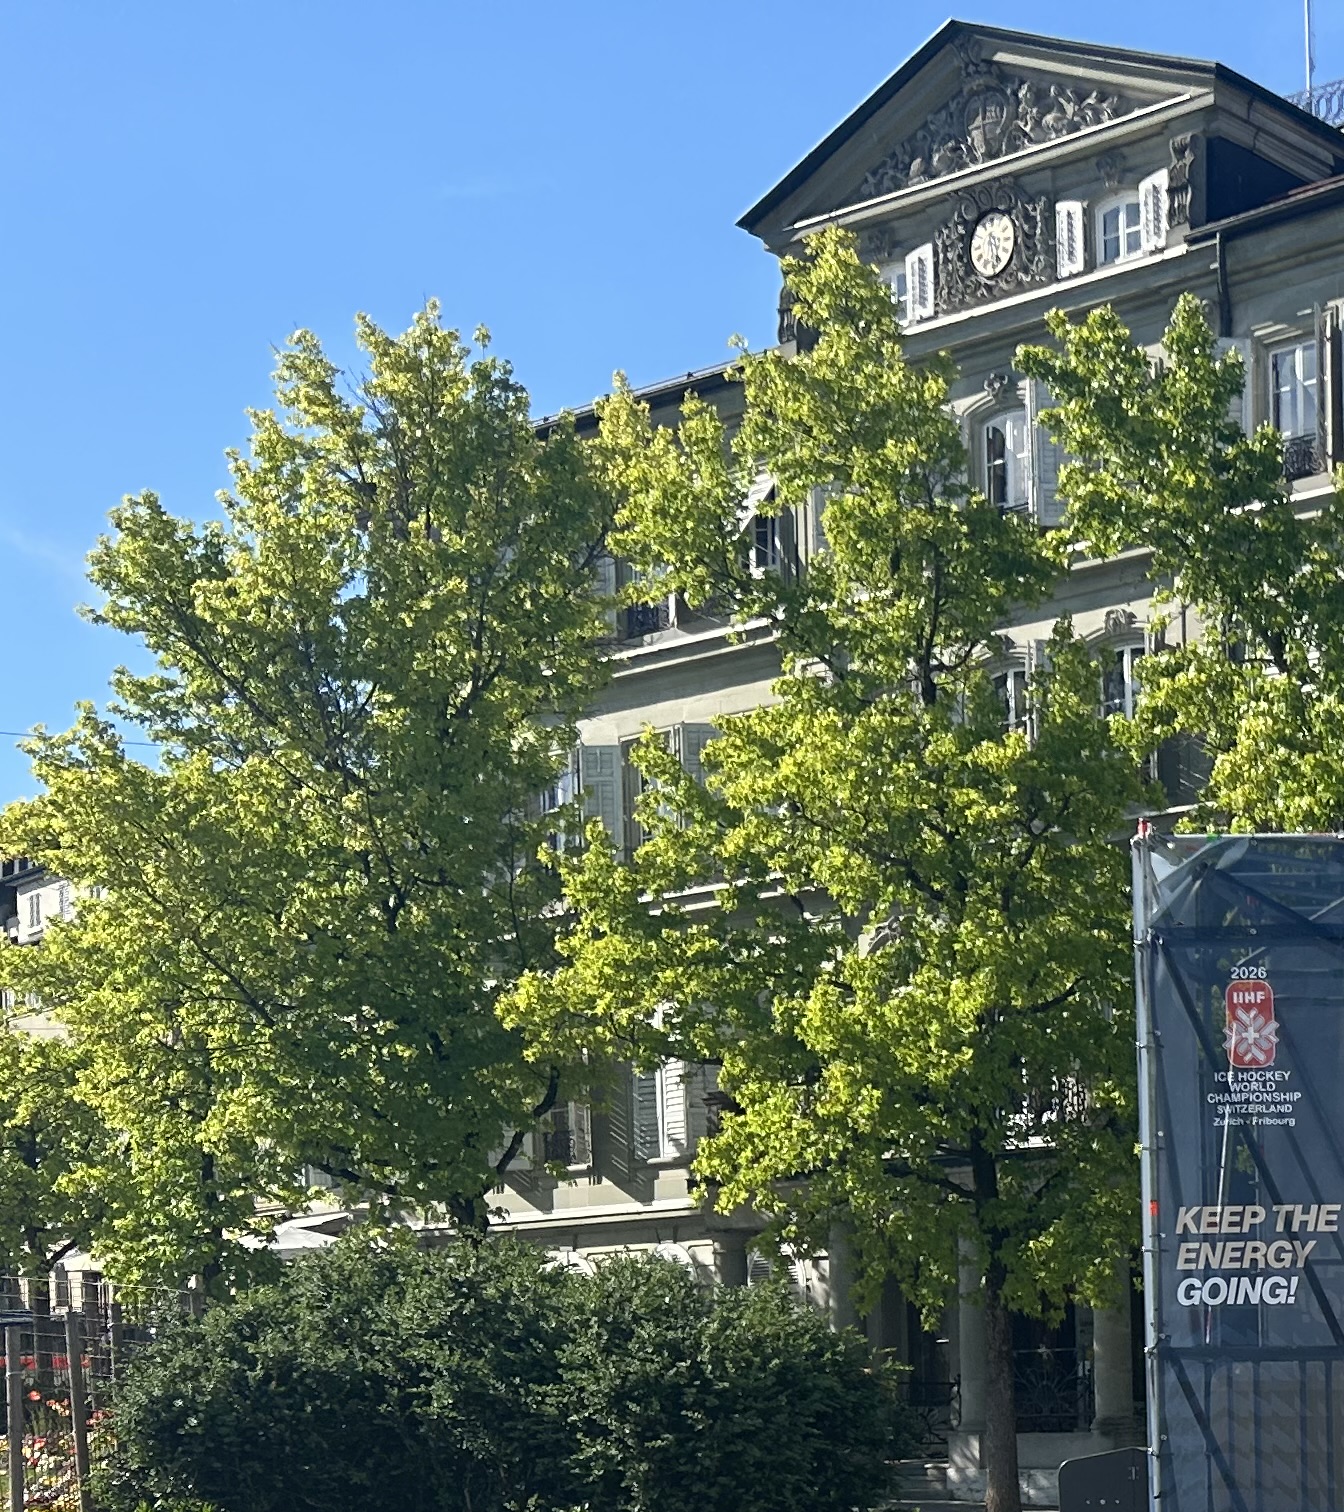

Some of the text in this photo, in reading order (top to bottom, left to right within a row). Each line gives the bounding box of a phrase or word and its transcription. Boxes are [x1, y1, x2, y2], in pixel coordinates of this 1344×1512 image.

[1230, 966, 1267, 979] 2026
[1232, 991, 1266, 1004] IIHF
[1214, 1071, 1291, 1082] ICE HOCKEY
[1230, 1081, 1276, 1092] WORLD
[1207, 1091, 1302, 1104] CHAMPIONSHIP
[1216, 1104, 1293, 1115] SWITZERLAND
[1252, 1116, 1296, 1127] Fribourg
[1175, 1204, 1341, 1235] KEEP THE
[1176, 1240, 1317, 1271] ENERGY
[1176, 1276, 1300, 1307] GOING!
